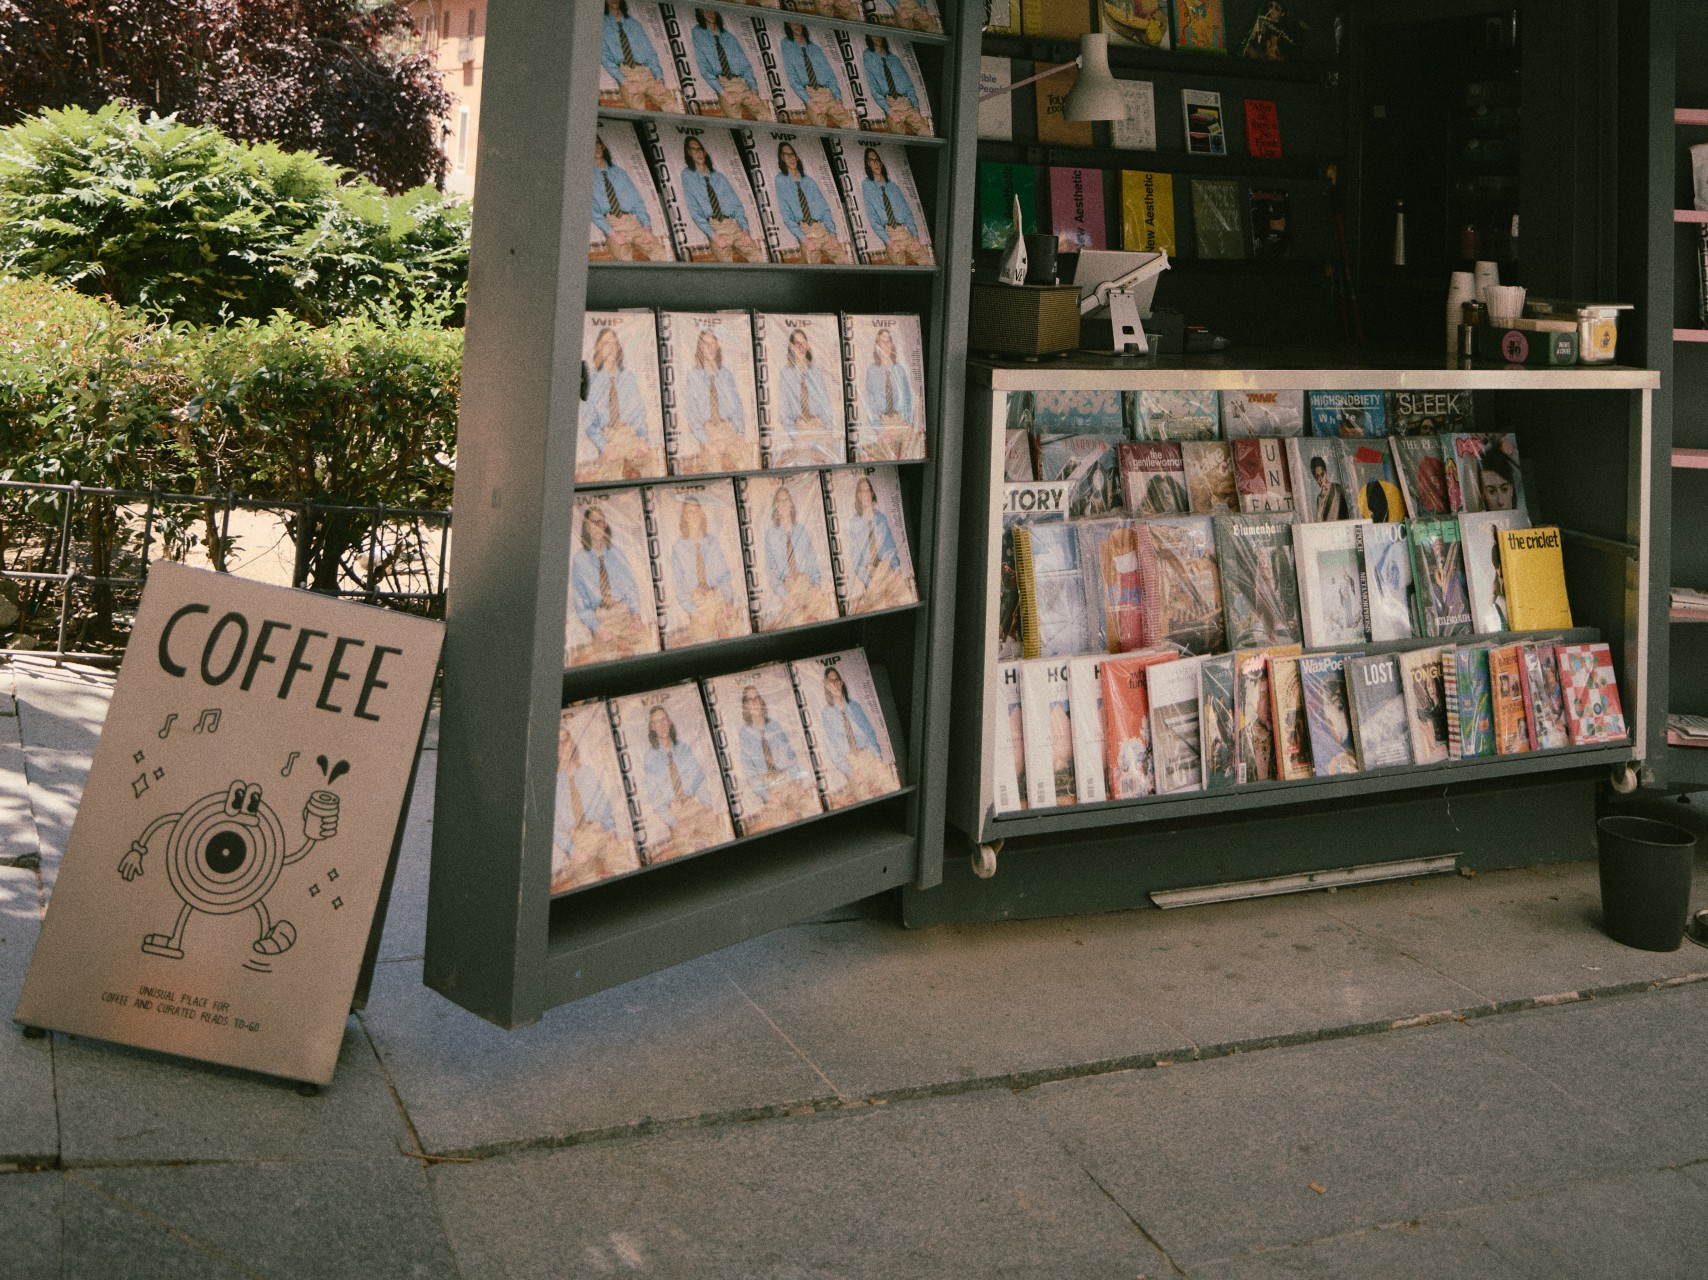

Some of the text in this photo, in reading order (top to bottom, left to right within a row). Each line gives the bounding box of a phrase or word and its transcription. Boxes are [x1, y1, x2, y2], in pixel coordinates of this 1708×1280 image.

[675, 125, 705, 136] WIP
[770, 131, 797, 142] WIP
[1073, 170, 1084, 223] Aesthetic
[1143, 173, 1155, 226] Aesthetic
[591, 318, 626, 327] WIP
[785, 319, 812, 328] WIP
[1246, 393, 1278, 404] TANK
[1399, 393, 1461, 415] SLEEK
[1149, 449, 1163, 459] the
[1003, 489, 1064, 512] TORY
[1508, 530, 1560, 551] the cricket
[158, 603, 403, 721] COFFEE
[1363, 661, 1394, 686] LOST
[139, 985, 231, 1012] UNUSUAL PLACE FOR
[101, 991, 260, 1033] COFFEE AND CURATED READS TO-GO
